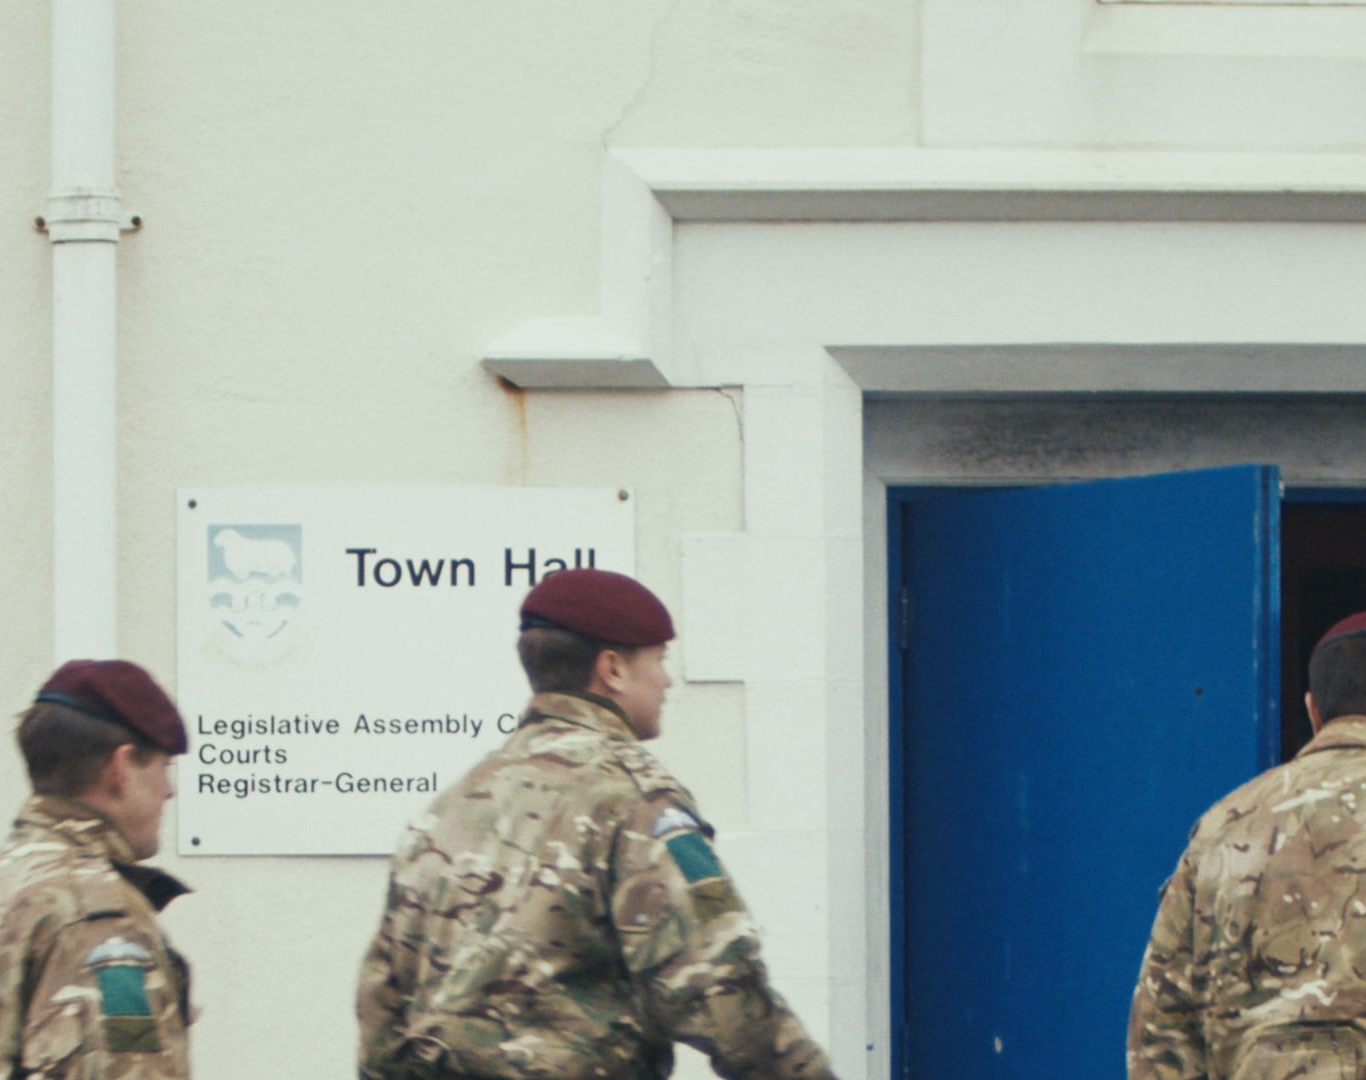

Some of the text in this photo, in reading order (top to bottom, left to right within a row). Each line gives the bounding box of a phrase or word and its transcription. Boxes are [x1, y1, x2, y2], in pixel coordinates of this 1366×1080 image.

[346, 547, 476, 587] Town
[197, 713, 340, 740] Legislative
[353, 713, 483, 739] Assembly
[198, 743, 288, 765] Courts
[197, 771, 438, 799] Registrar-General
